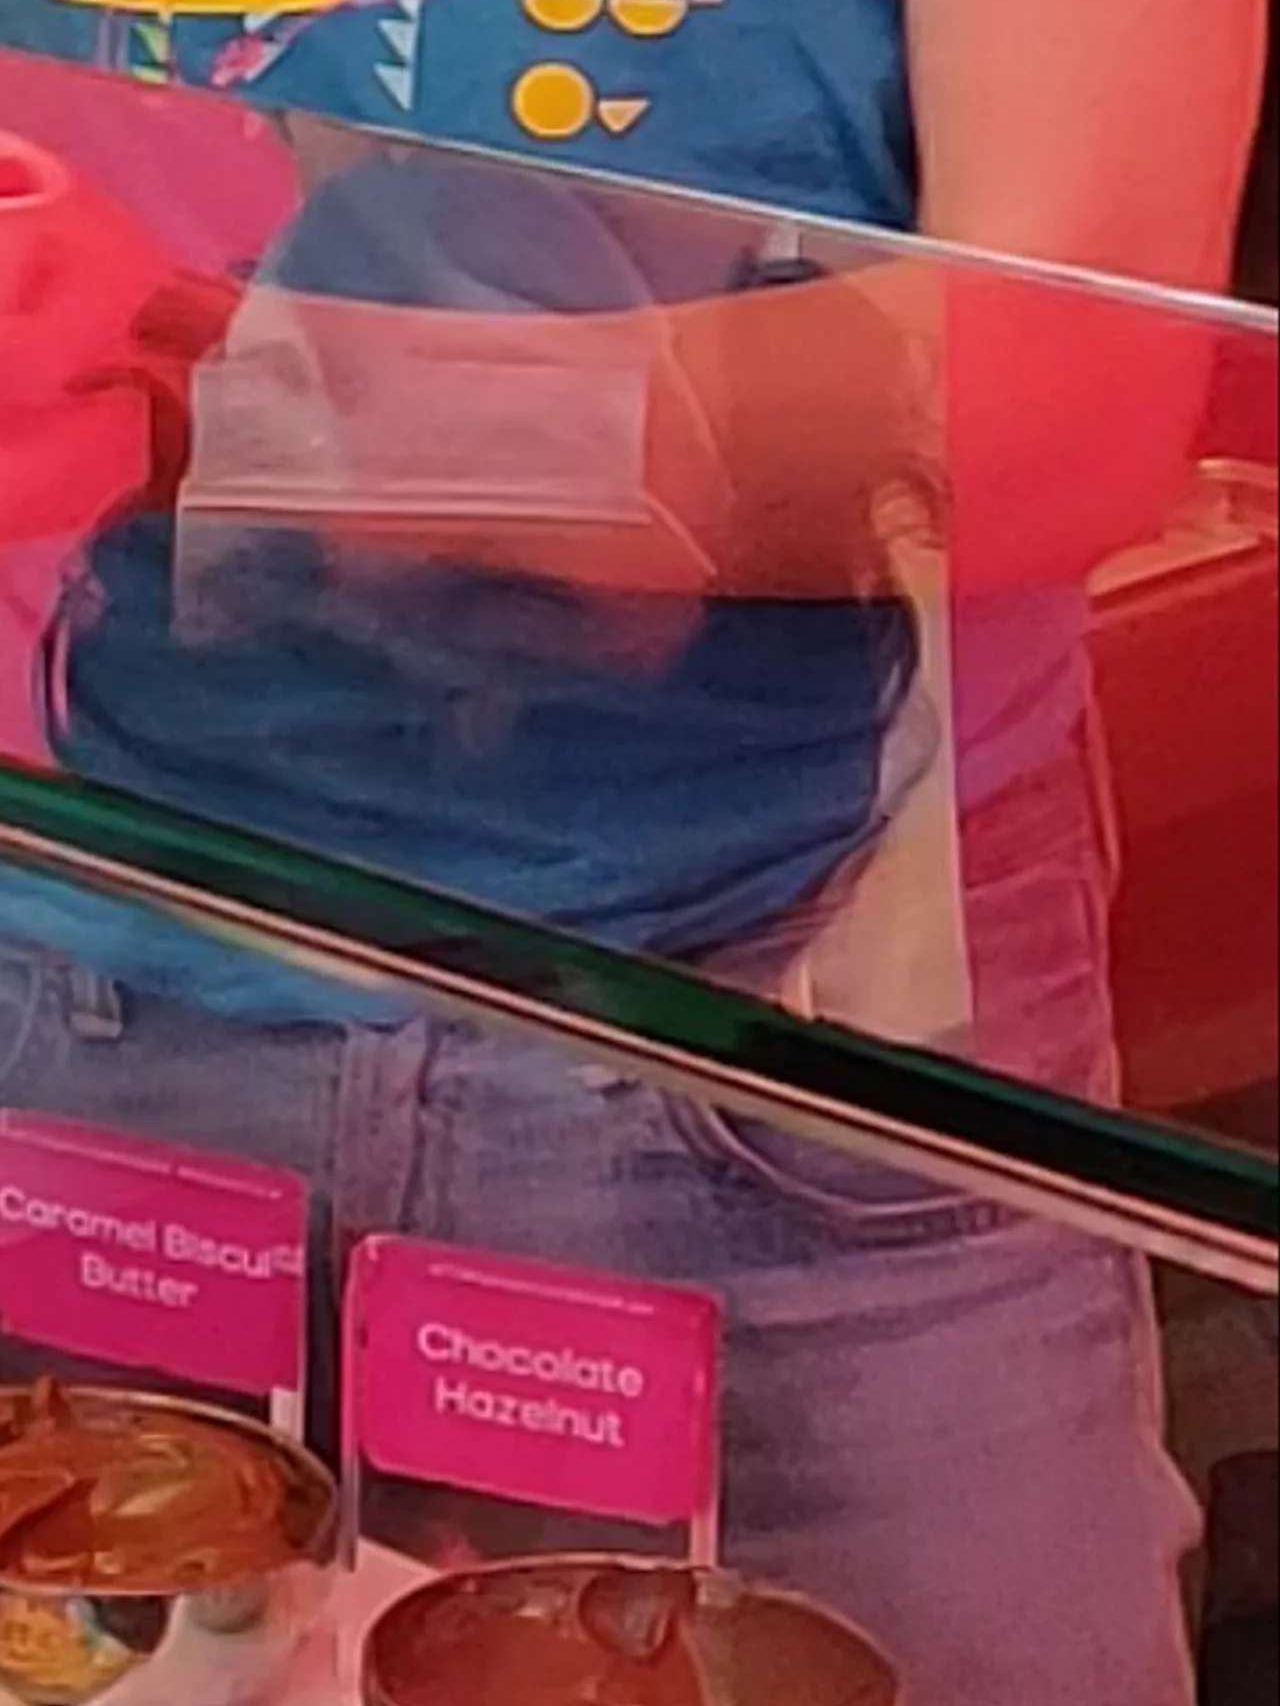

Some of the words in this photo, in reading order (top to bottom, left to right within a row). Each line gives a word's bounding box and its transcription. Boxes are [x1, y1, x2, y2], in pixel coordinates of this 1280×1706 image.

[81, 1251, 197, 1308] Butter
[417, 1323, 643, 1397] Chocolate
[435, 1378, 624, 1447] Hazelnut
